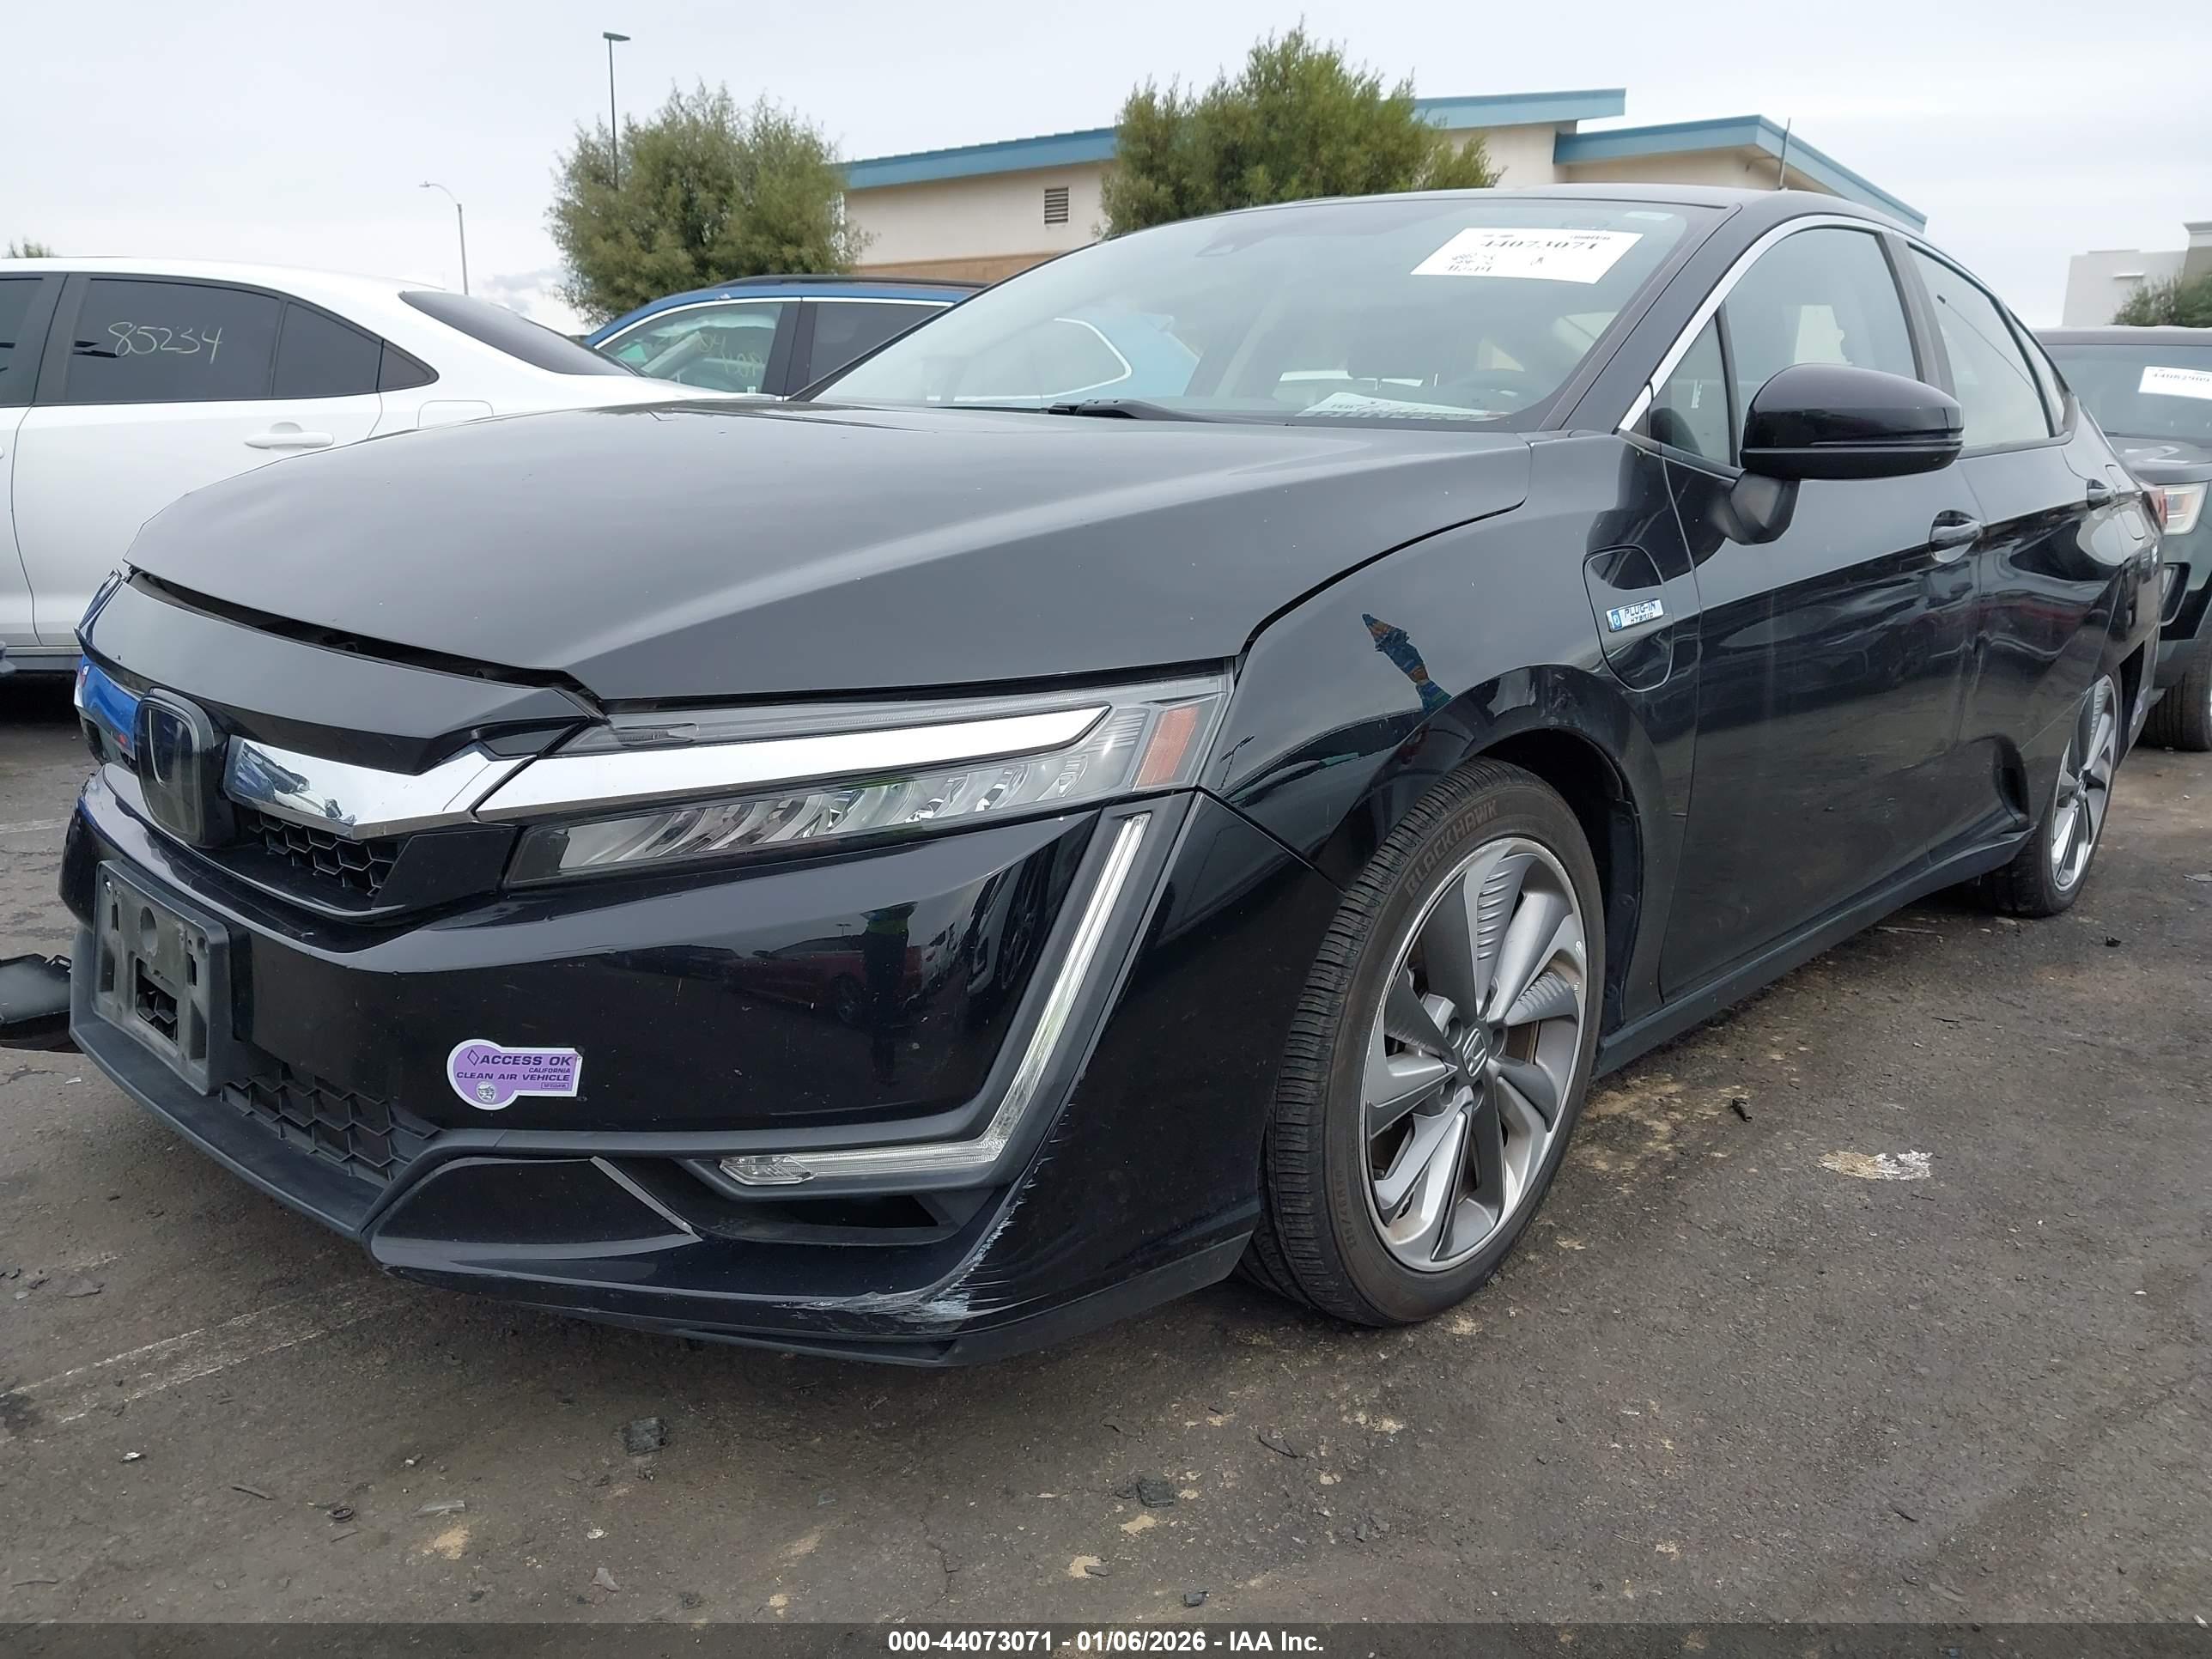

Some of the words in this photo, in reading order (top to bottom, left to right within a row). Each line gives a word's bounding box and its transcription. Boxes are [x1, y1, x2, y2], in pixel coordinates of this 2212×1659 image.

[1624, 601, 1656, 618] PLUG-IN
[1631, 612, 1654, 623] HYBRID
[1403, 799, 1497, 897] BLACKHAWK
[479, 1054, 543, 1066] ACCESS
[549, 1056, 573, 1066] OK
[456, 1072, 494, 1080] CLEAN
